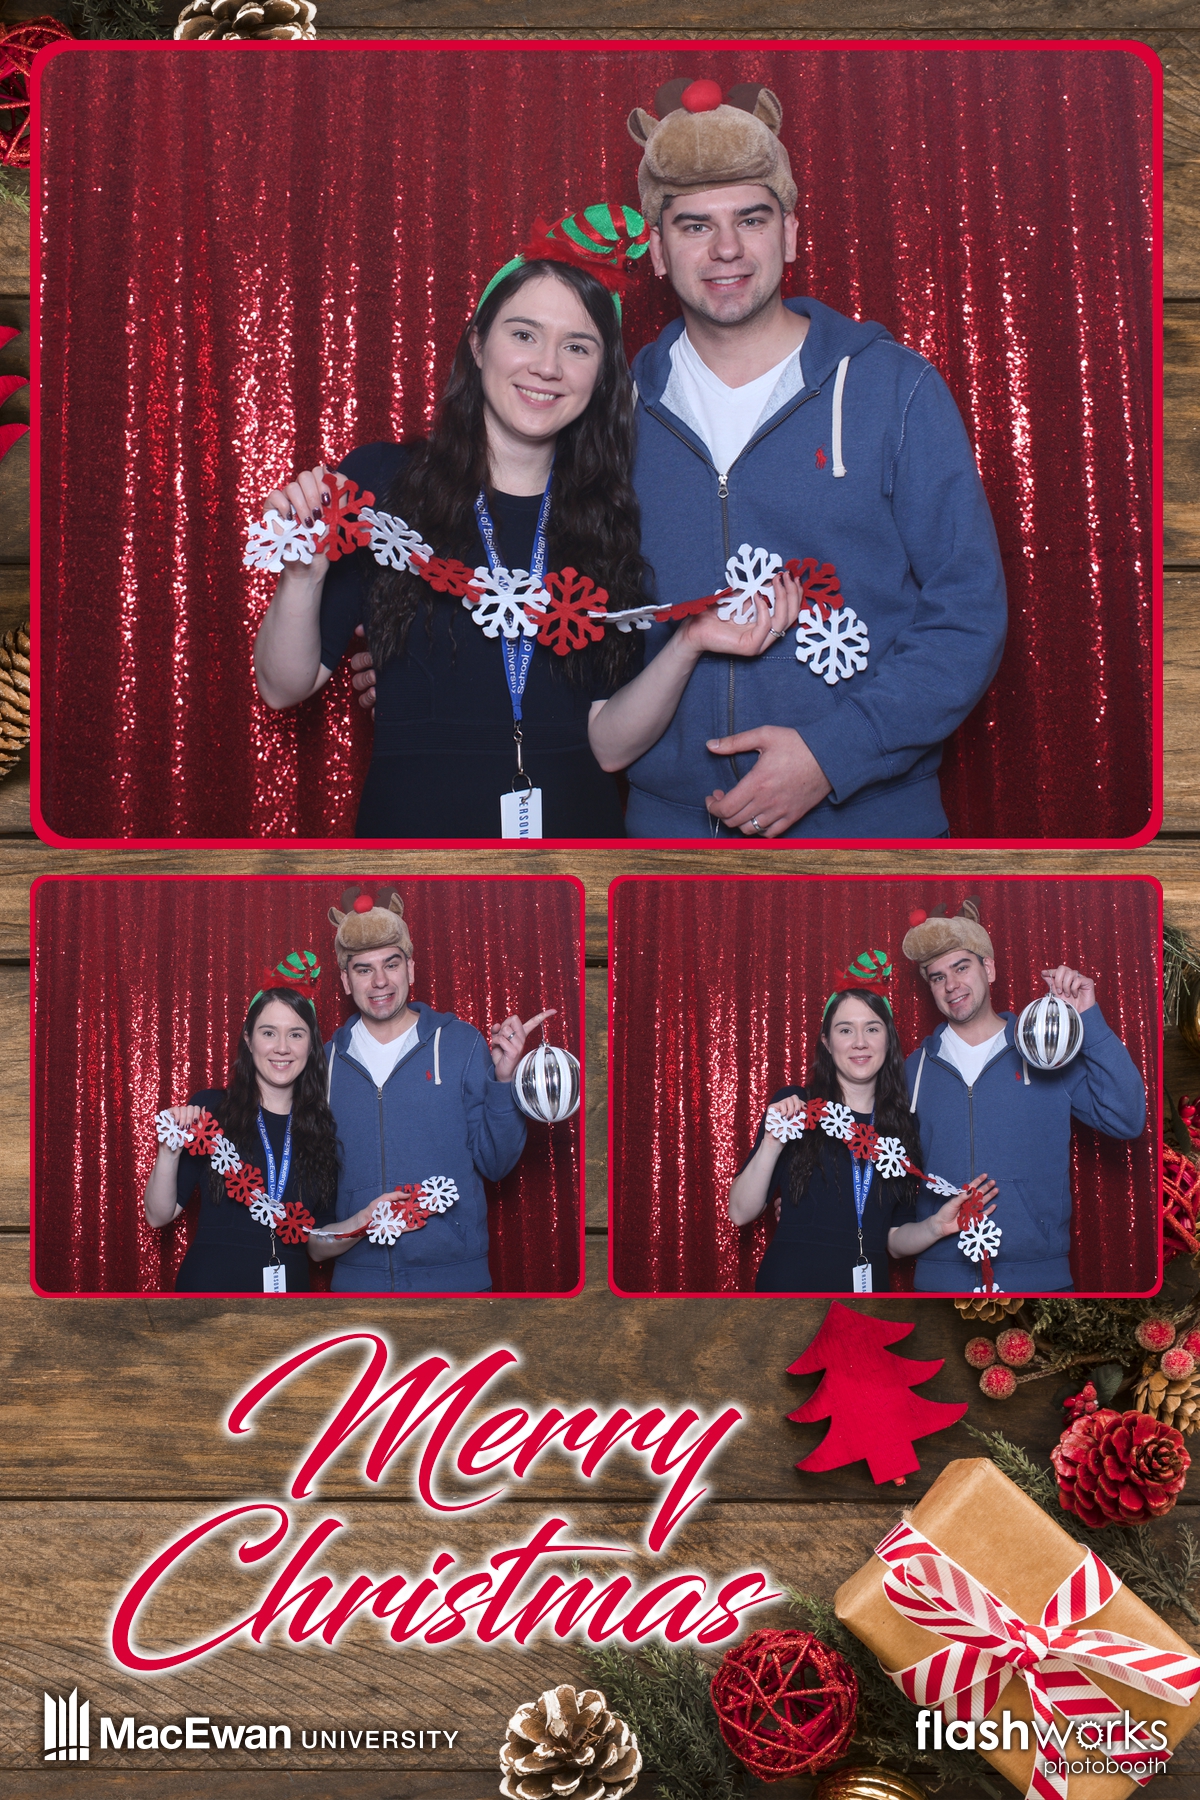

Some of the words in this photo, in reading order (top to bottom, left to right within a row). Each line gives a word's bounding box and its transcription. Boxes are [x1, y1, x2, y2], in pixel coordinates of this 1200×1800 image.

[476, 493, 488, 514] hool
[480, 516, 492, 526] of
[537, 492, 553, 535] University
[483, 528, 502, 569] Business
[532, 536, 546, 578] MacEwan
[522, 639, 533, 651] of
[506, 638, 517, 694] University
[516, 654, 529, 695] School
[519, 796, 529, 839] ERSON
[267, 1153, 276, 1182] MacEwan
